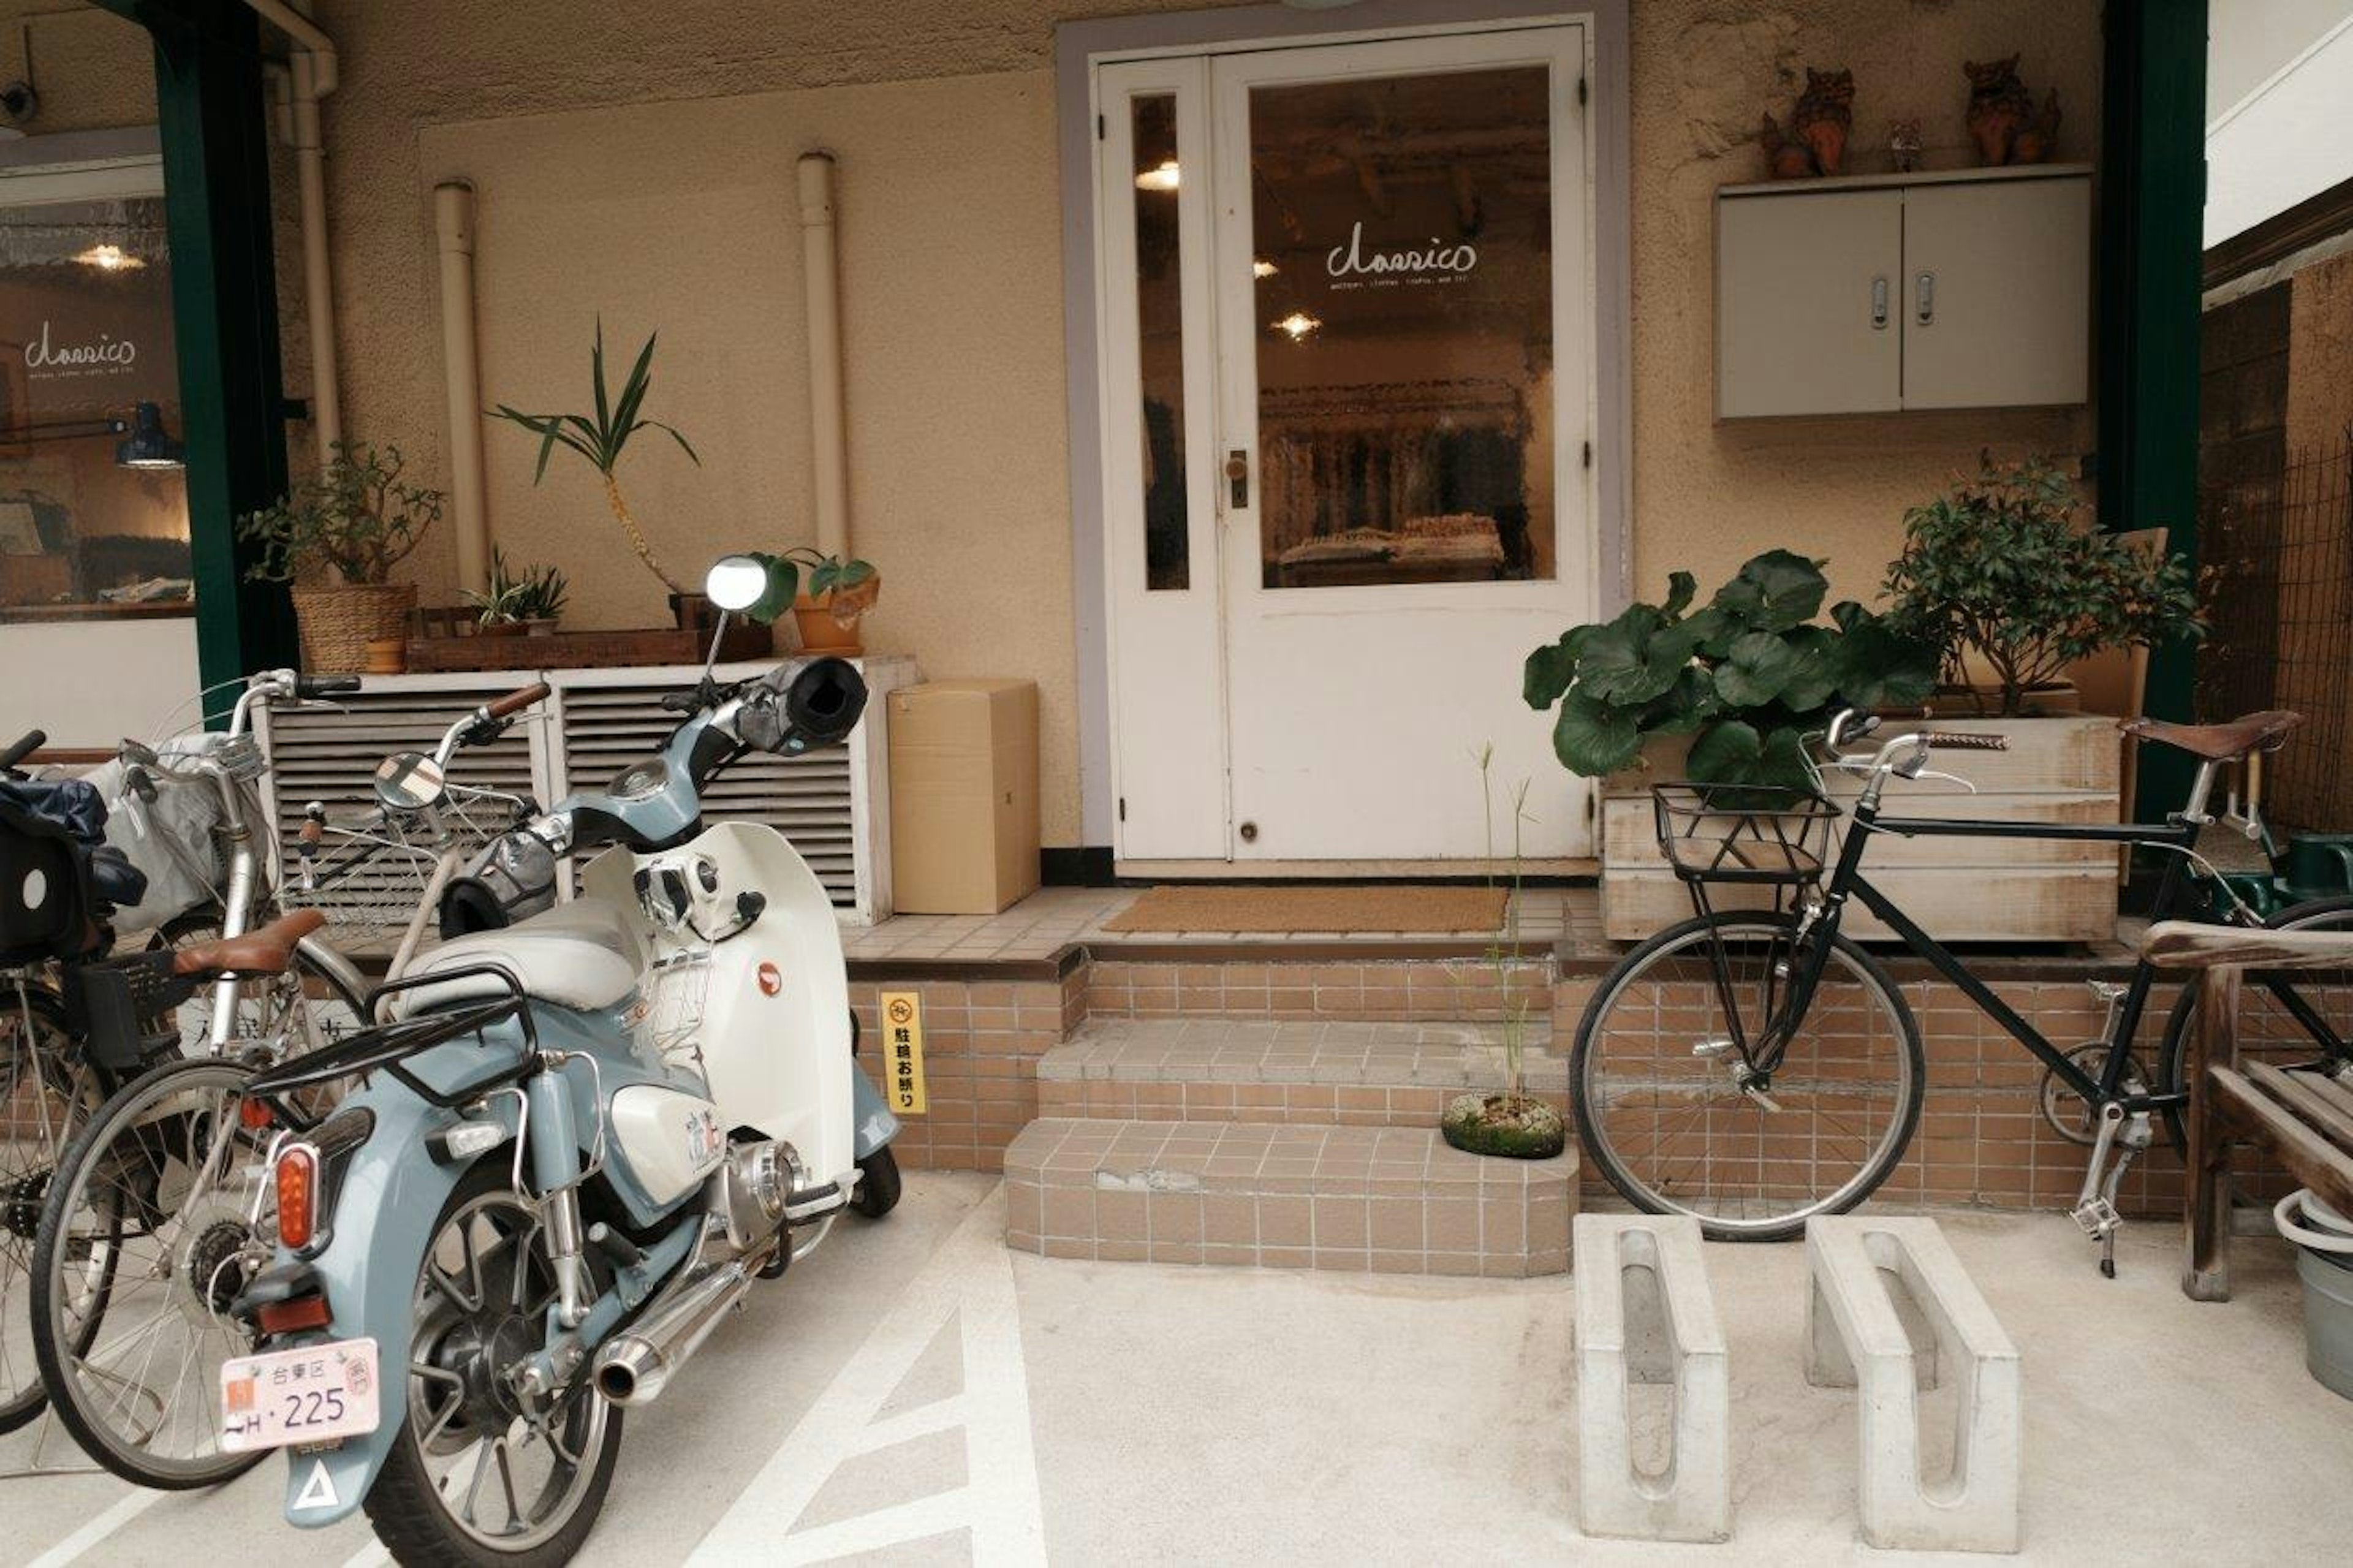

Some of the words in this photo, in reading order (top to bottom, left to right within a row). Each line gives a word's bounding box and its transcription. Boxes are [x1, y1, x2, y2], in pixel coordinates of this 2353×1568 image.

[1327, 221, 1477, 277] classico
[25, 320, 135, 368] classico
[895, 1027, 913, 1107] 駐輪お断り
[272, 1360, 324, 1385] 台東区
